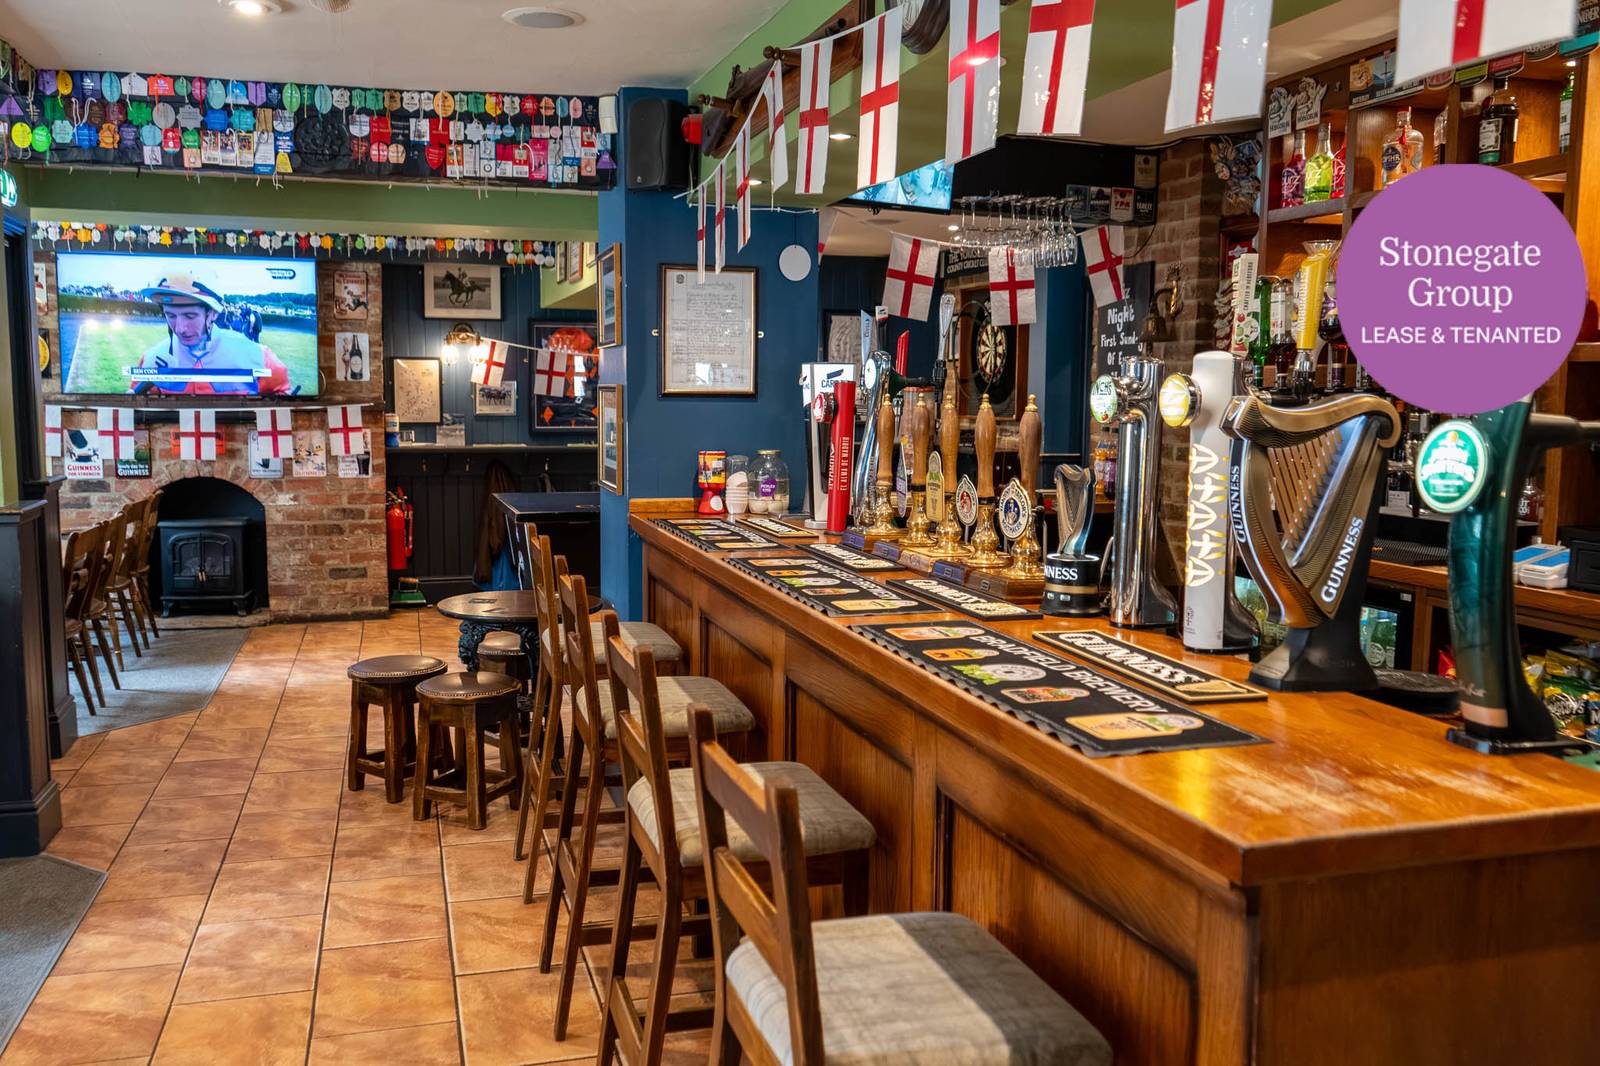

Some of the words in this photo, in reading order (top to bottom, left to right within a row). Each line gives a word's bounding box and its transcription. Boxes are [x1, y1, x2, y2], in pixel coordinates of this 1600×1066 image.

[1106, 303, 1136, 332] Night
[1100, 333, 1117, 348] First
[841, 436, 850, 458] MADRID
[118, 468, 149, 476] GUINNESS
[840, 467, 849, 483] ALMA
[1230, 465, 1247, 543] GUINNESS
[1320, 516, 1365, 603] GUINNESS
[1058, 632, 1206, 683] GUINNESS
[969, 635, 1077, 672] BRADFIELD
[1061, 669, 1168, 713] BREWERY
